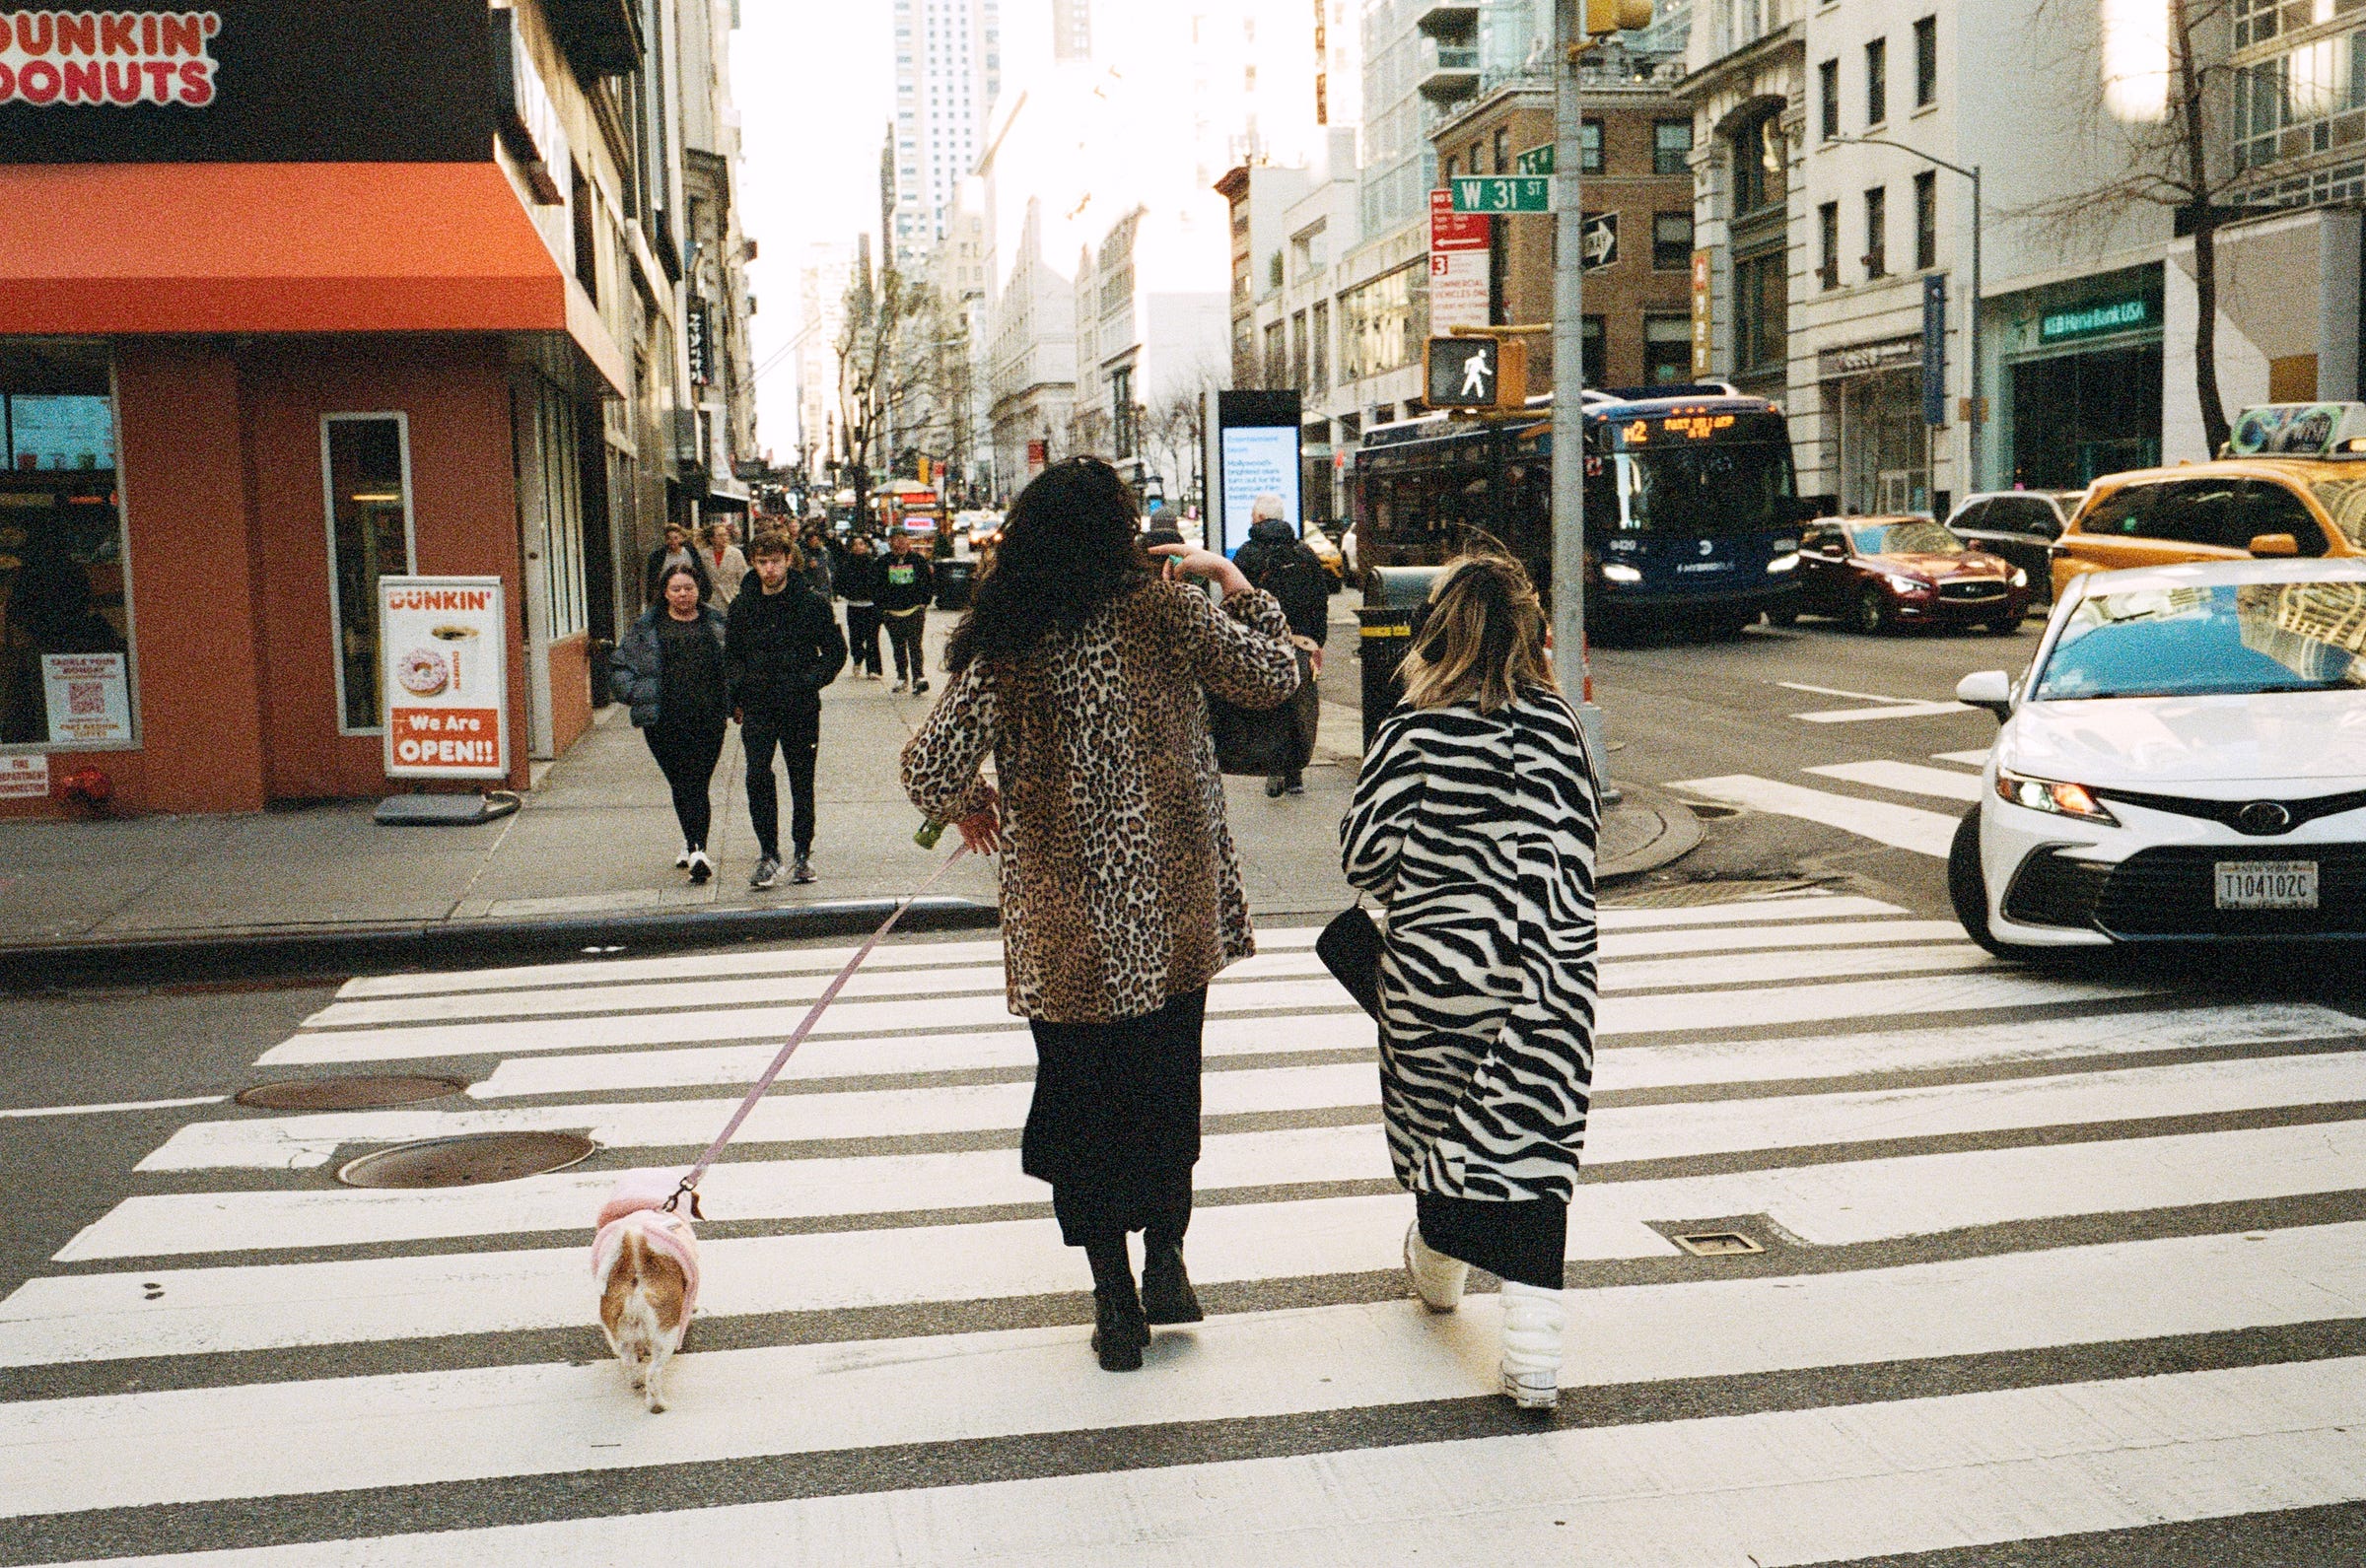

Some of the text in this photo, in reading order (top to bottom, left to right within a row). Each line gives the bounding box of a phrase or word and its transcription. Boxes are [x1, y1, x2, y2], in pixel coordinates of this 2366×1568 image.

[1461, 180, 1542, 209] W 31 ST
[1434, 257, 1446, 275] 3
[388, 590, 492, 611] DUNKIN'
[409, 715, 480, 731] We Are
[398, 740, 493, 762] OPEN!!
[2224, 875, 2308, 898] T104102C
